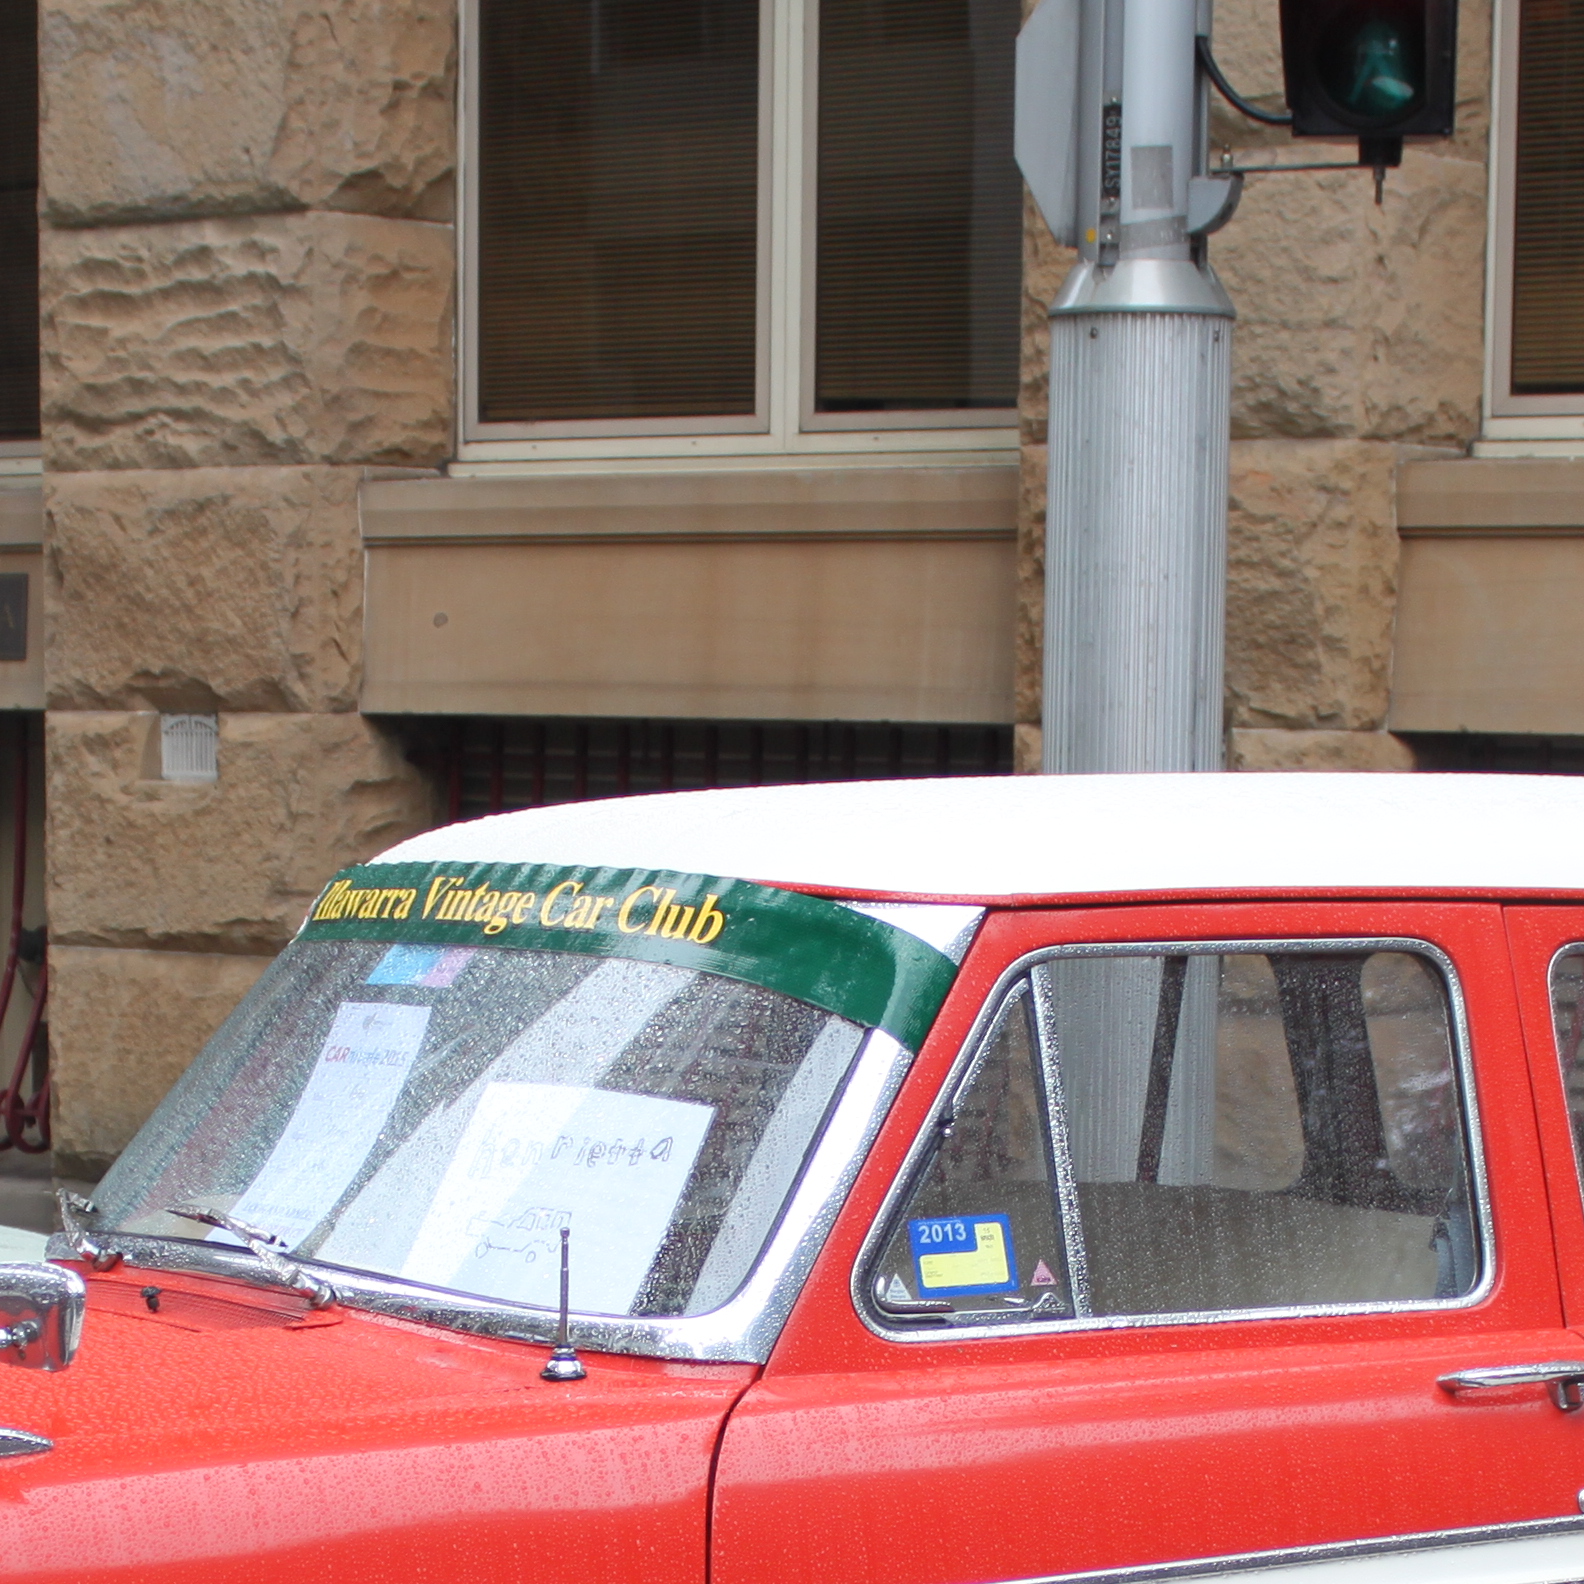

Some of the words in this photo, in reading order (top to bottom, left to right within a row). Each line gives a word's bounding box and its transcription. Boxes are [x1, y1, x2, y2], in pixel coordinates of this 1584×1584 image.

[312, 879, 417, 920] Illawarra
[421, 876, 535, 935] Vintage
[539, 880, 615, 930] Car
[617, 884, 724, 944] Club
[918, 1223, 967, 1243] 2013
